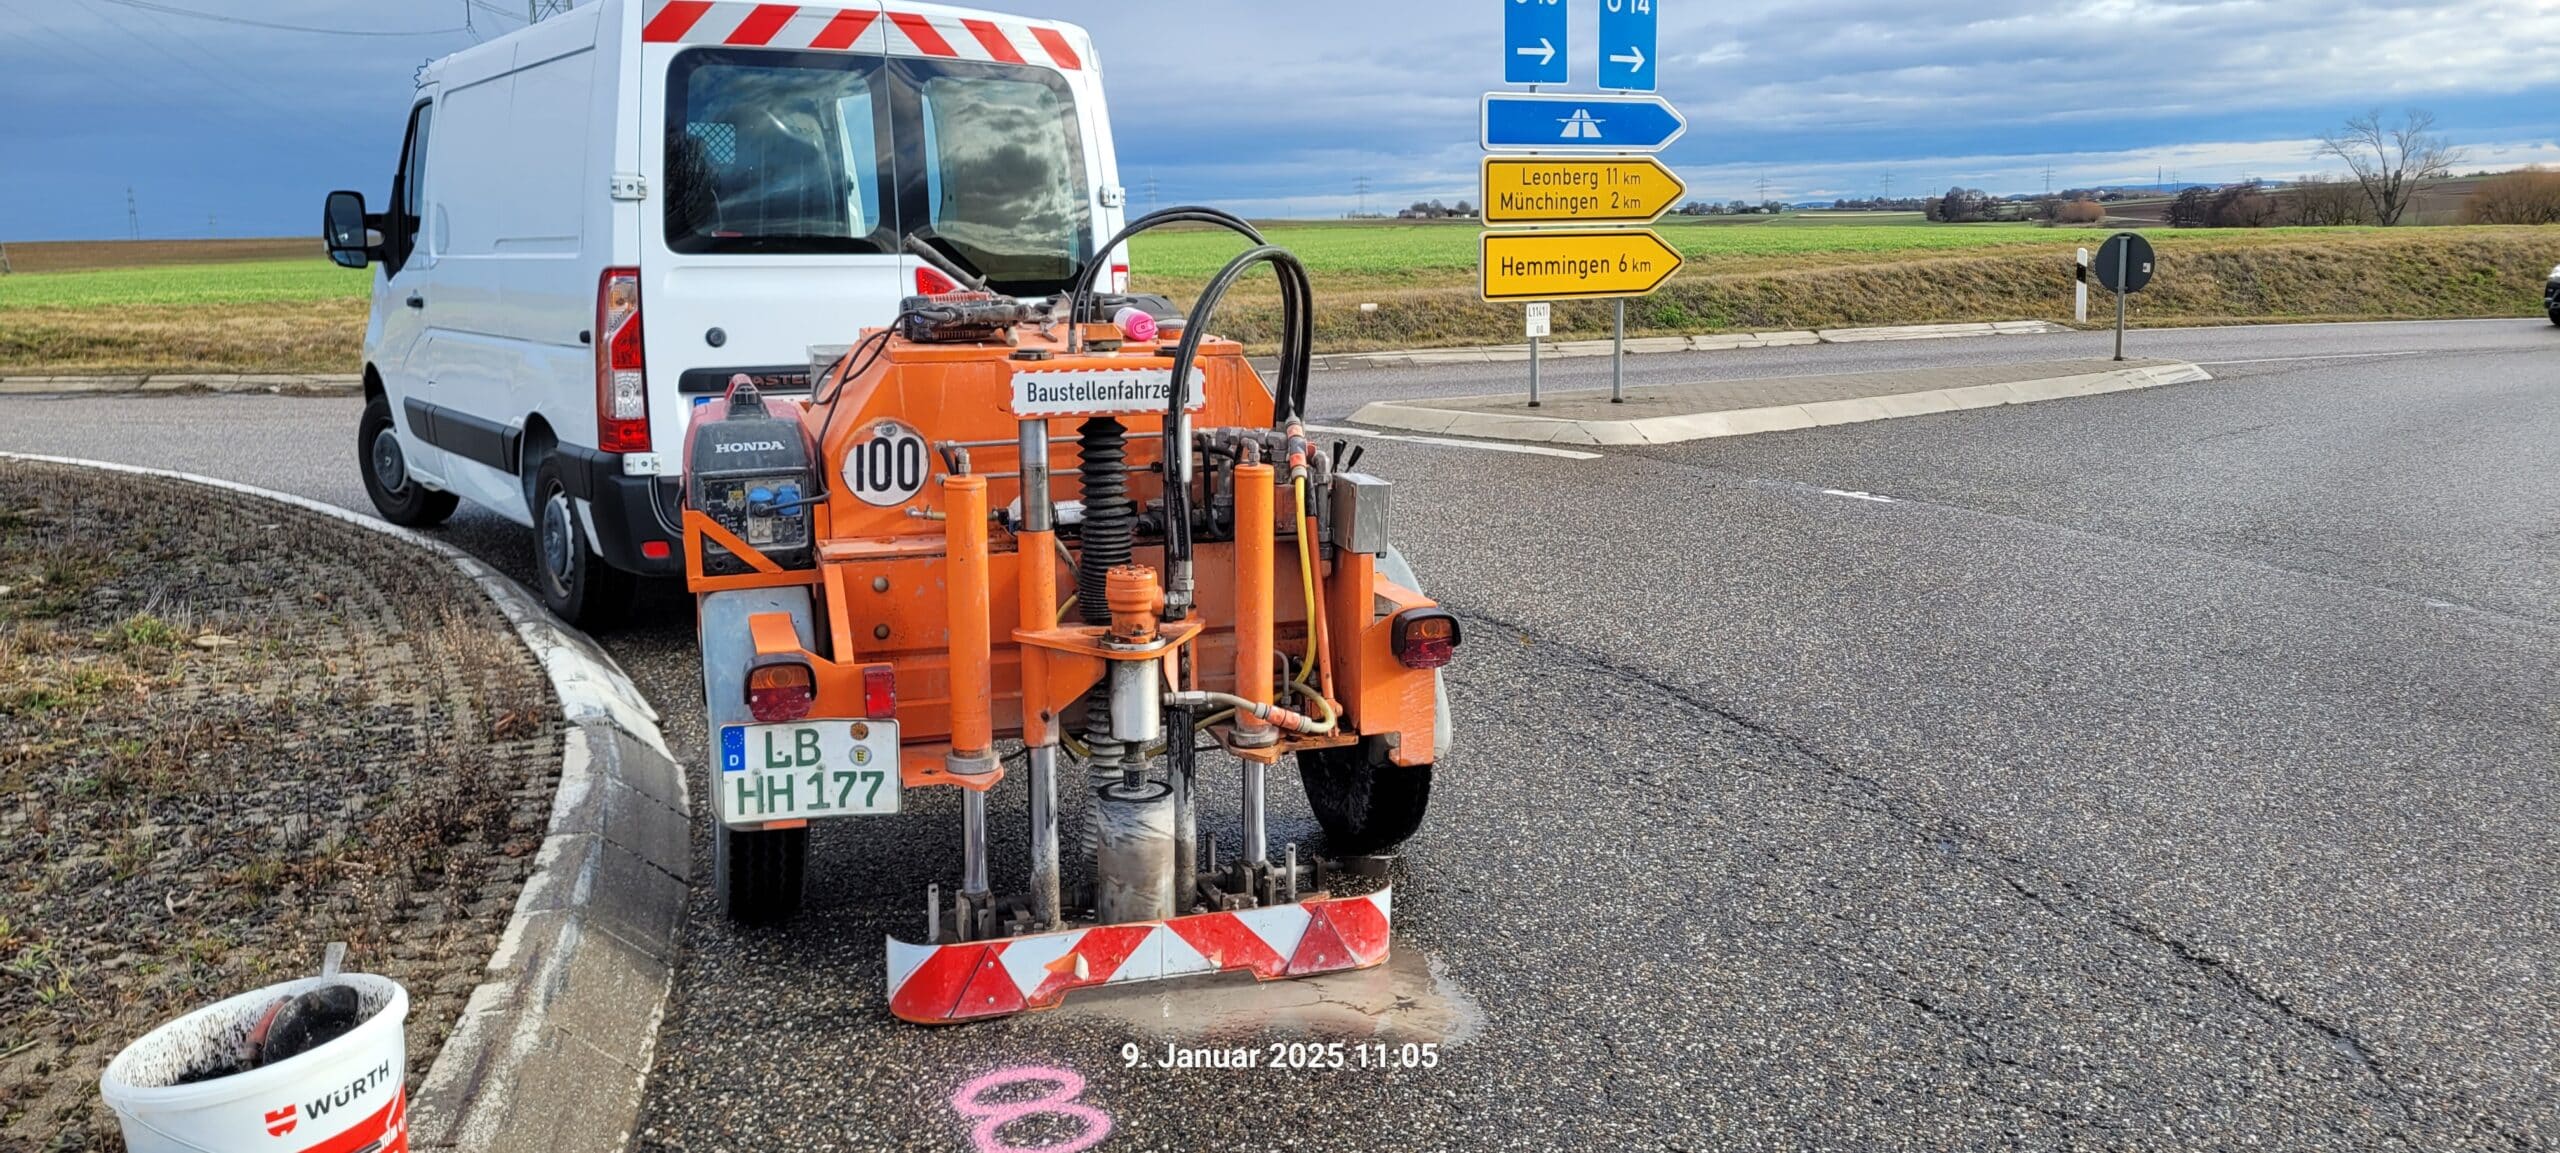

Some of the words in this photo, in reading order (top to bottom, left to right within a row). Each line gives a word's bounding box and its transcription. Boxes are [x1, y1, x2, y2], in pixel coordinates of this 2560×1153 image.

[1522, 167, 1598, 190] Leonberg
[1606, 168, 1618, 185] 11
[1623, 172, 1641, 185] km
[1500, 191, 1598, 214] Münchingen
[1611, 191, 1619, 209] 2
[1623, 196, 1641, 209] km
[1501, 255, 1610, 279] Hemmingen
[1618, 253, 1628, 273] 6
[1632, 258, 1651, 272] km
[1027, 379, 1190, 403] Baustellenfahrze
[715, 440, 785, 453] HONDA
[856, 437, 919, 491] 100
[729, 755, 739, 766] D
[765, 728, 822, 768] LB
[737, 774, 794, 815] HH
[806, 771, 884, 810] 177
[305, 1059, 389, 1120] WÜRTH
